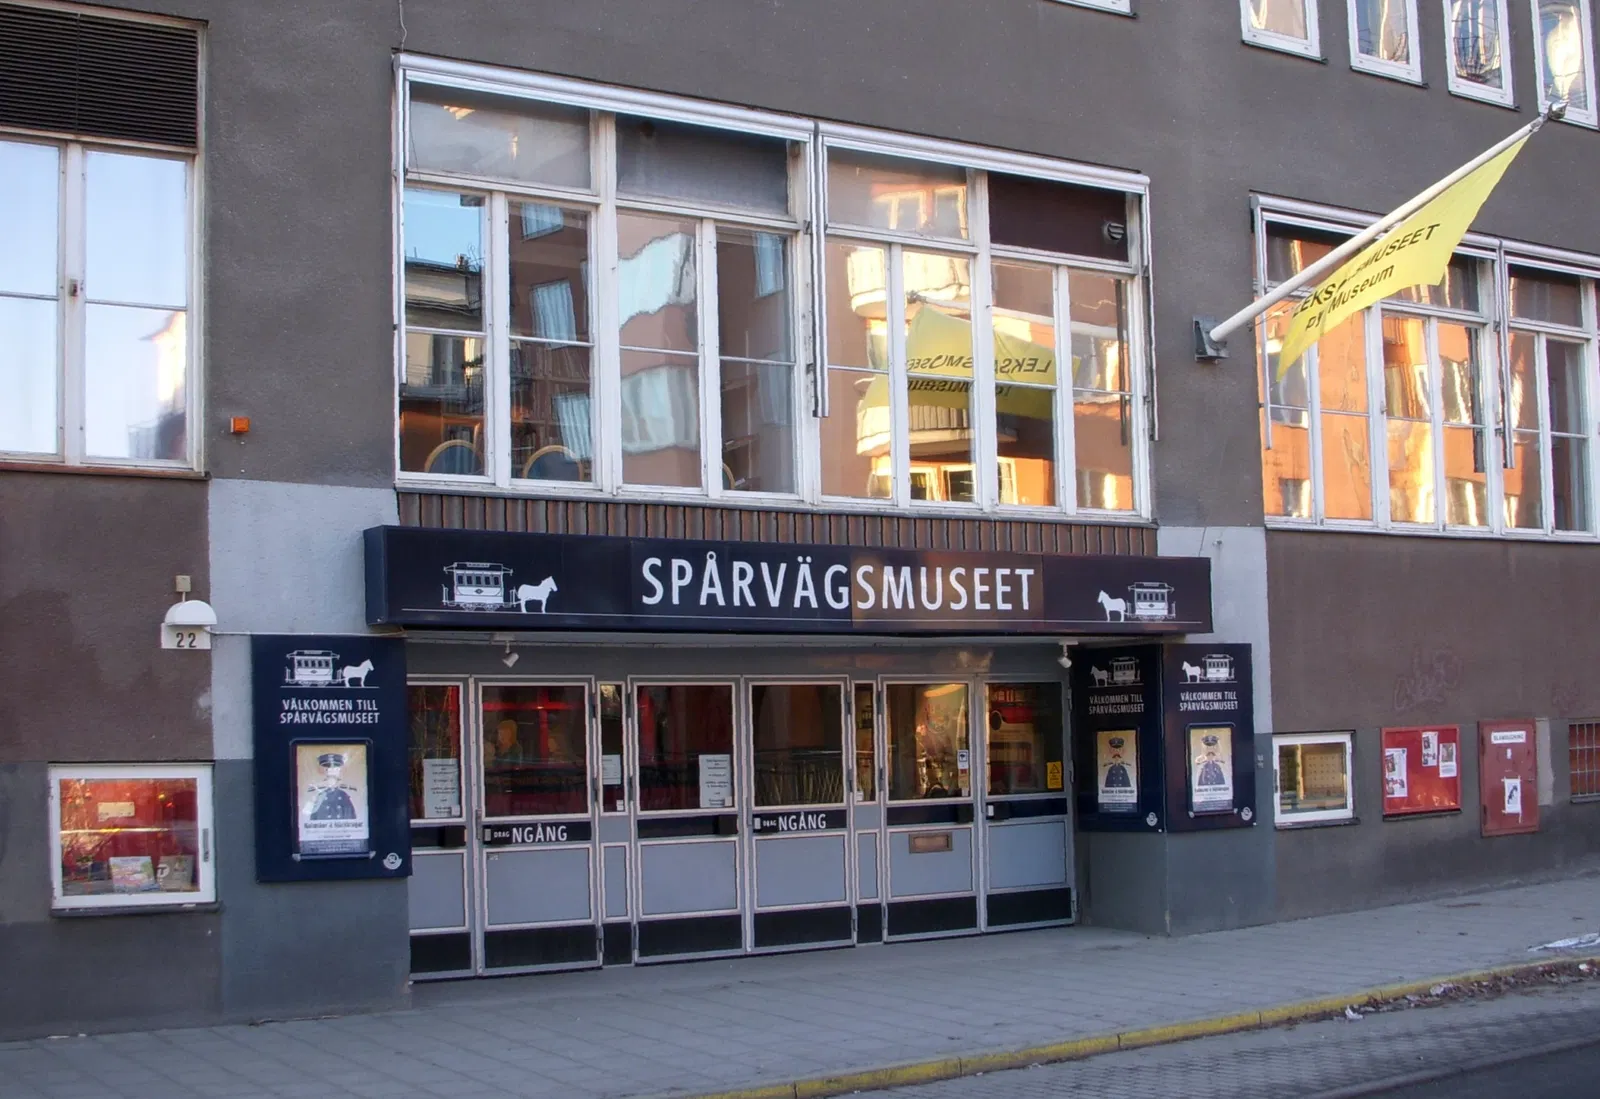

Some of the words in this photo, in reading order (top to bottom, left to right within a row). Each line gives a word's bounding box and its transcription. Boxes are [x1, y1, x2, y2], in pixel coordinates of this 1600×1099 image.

[1328, 265, 1395, 314] Museum
[642, 551, 1034, 611] SPÅRVÄGSMUSEET
[176, 631, 197, 648] 22
[1089, 694, 1129, 705] VÄLKOMMEN
[1131, 694, 1143, 703] TILL
[1180, 691, 1222, 701] VÄLKOMMEN
[1224, 691, 1237, 700] TILL
[282, 698, 352, 711] VÄLKOMMEN
[357, 700, 378, 710] TILL
[1089, 703, 1145, 714] SPÅRVÄGSMUSEET
[1179, 701, 1238, 711] SPÅRVÄGSMUSEET
[280, 711, 380, 724] SPÅRVÄGSMUSEET
[778, 812, 827, 831] NGÅNG
[512, 823, 568, 843] NGÅNG
